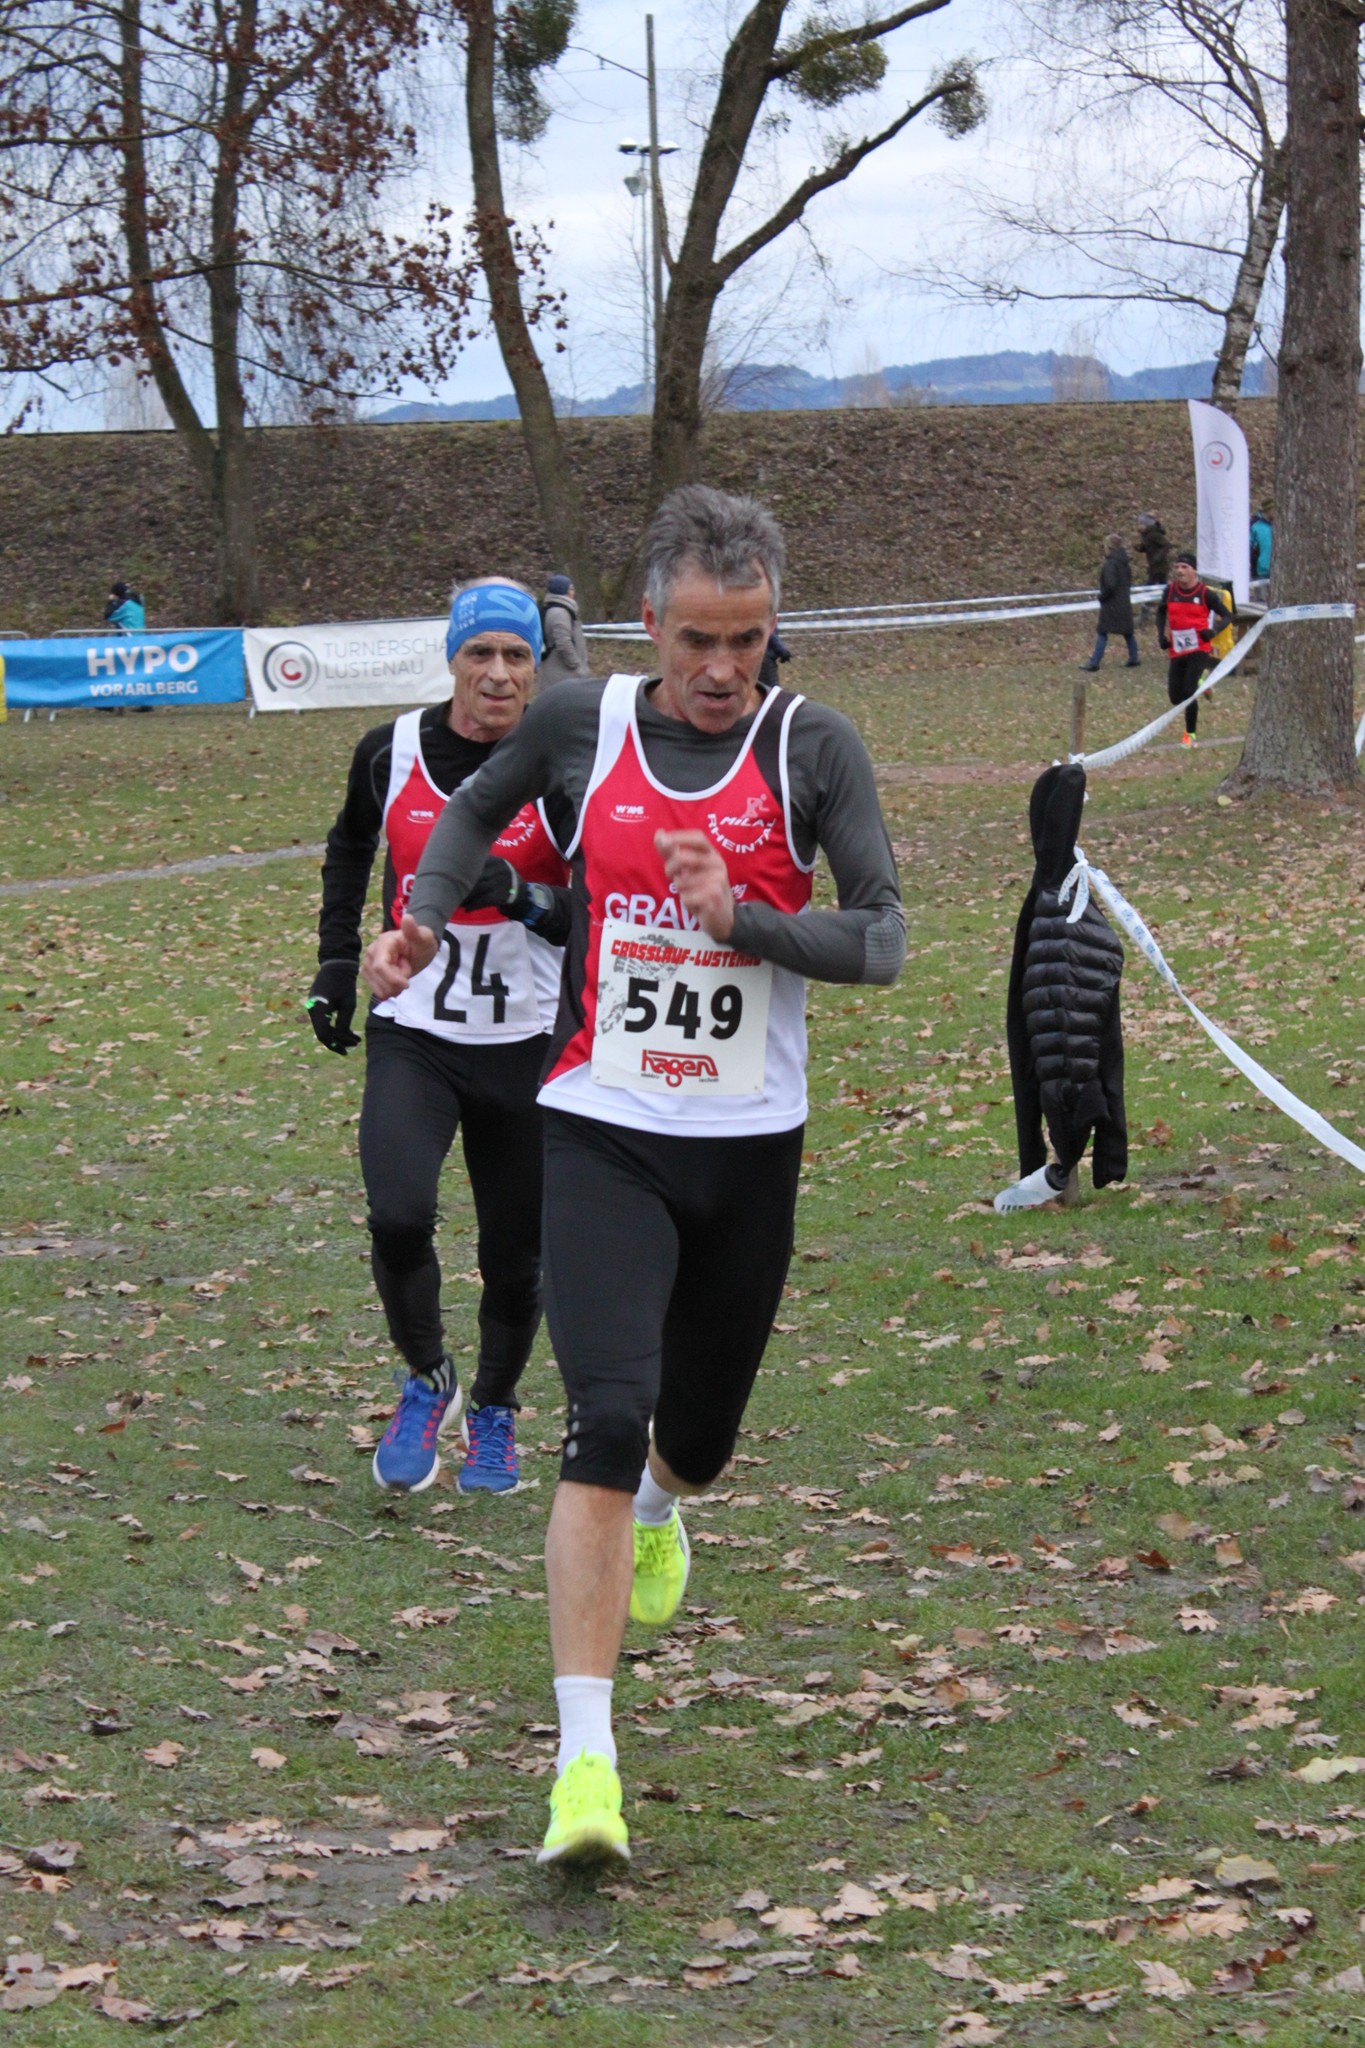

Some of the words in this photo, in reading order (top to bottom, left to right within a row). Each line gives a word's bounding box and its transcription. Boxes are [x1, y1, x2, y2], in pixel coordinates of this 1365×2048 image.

[87, 643, 199, 678] HYPO
[324, 637, 447, 659] TURNERSCHA
[325, 659, 425, 680] LUSTENAU
[89, 680, 199, 699] VORARLBERG
[707, 813, 777, 854] RHEINTAL
[433, 928, 510, 1024] 24
[624, 976, 744, 1041] 549
[640, 1048, 720, 1088] hagen
